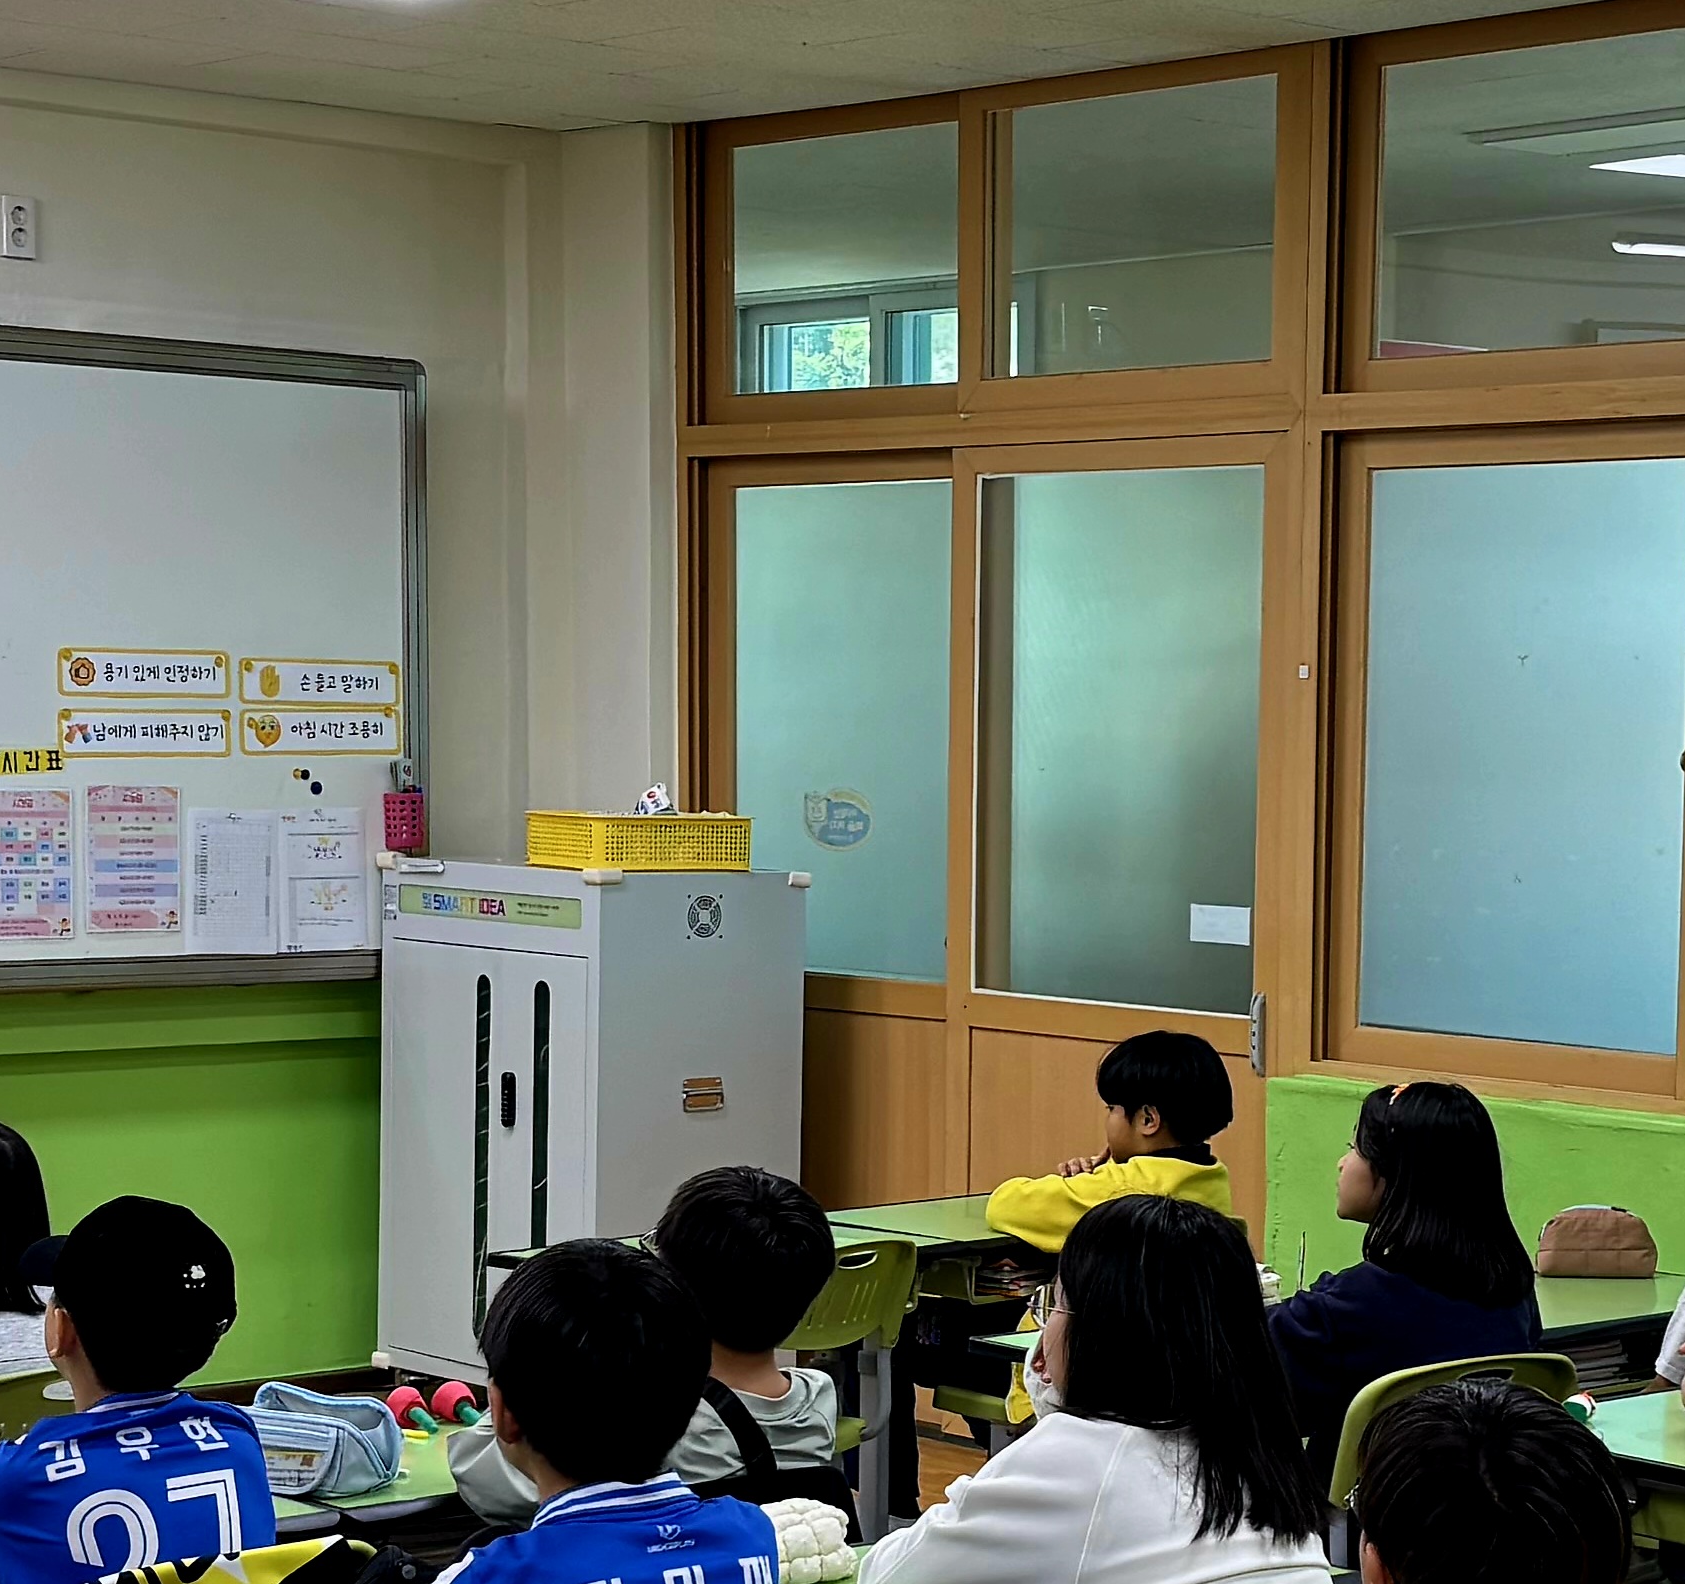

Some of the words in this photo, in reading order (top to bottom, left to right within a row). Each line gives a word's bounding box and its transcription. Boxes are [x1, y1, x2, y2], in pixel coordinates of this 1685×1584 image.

[103, 662, 128, 682] 용기
[132, 664, 160, 683] 있게
[164, 665, 217, 683] 인정하기
[299, 673, 311, 691] 손
[314, 673, 337, 693] 들고
[341, 674, 379, 693] 말하기
[93, 722, 137, 742] 남에게
[198, 724, 225, 742] 않기
[291, 721, 317, 739] 아침
[320, 722, 345, 738] 시간
[348, 720, 384, 738] 조용히
[2, 750, 64, 773] 시간표
[433, 893, 476, 915] SMART
[478, 897, 506, 917] IDEA
